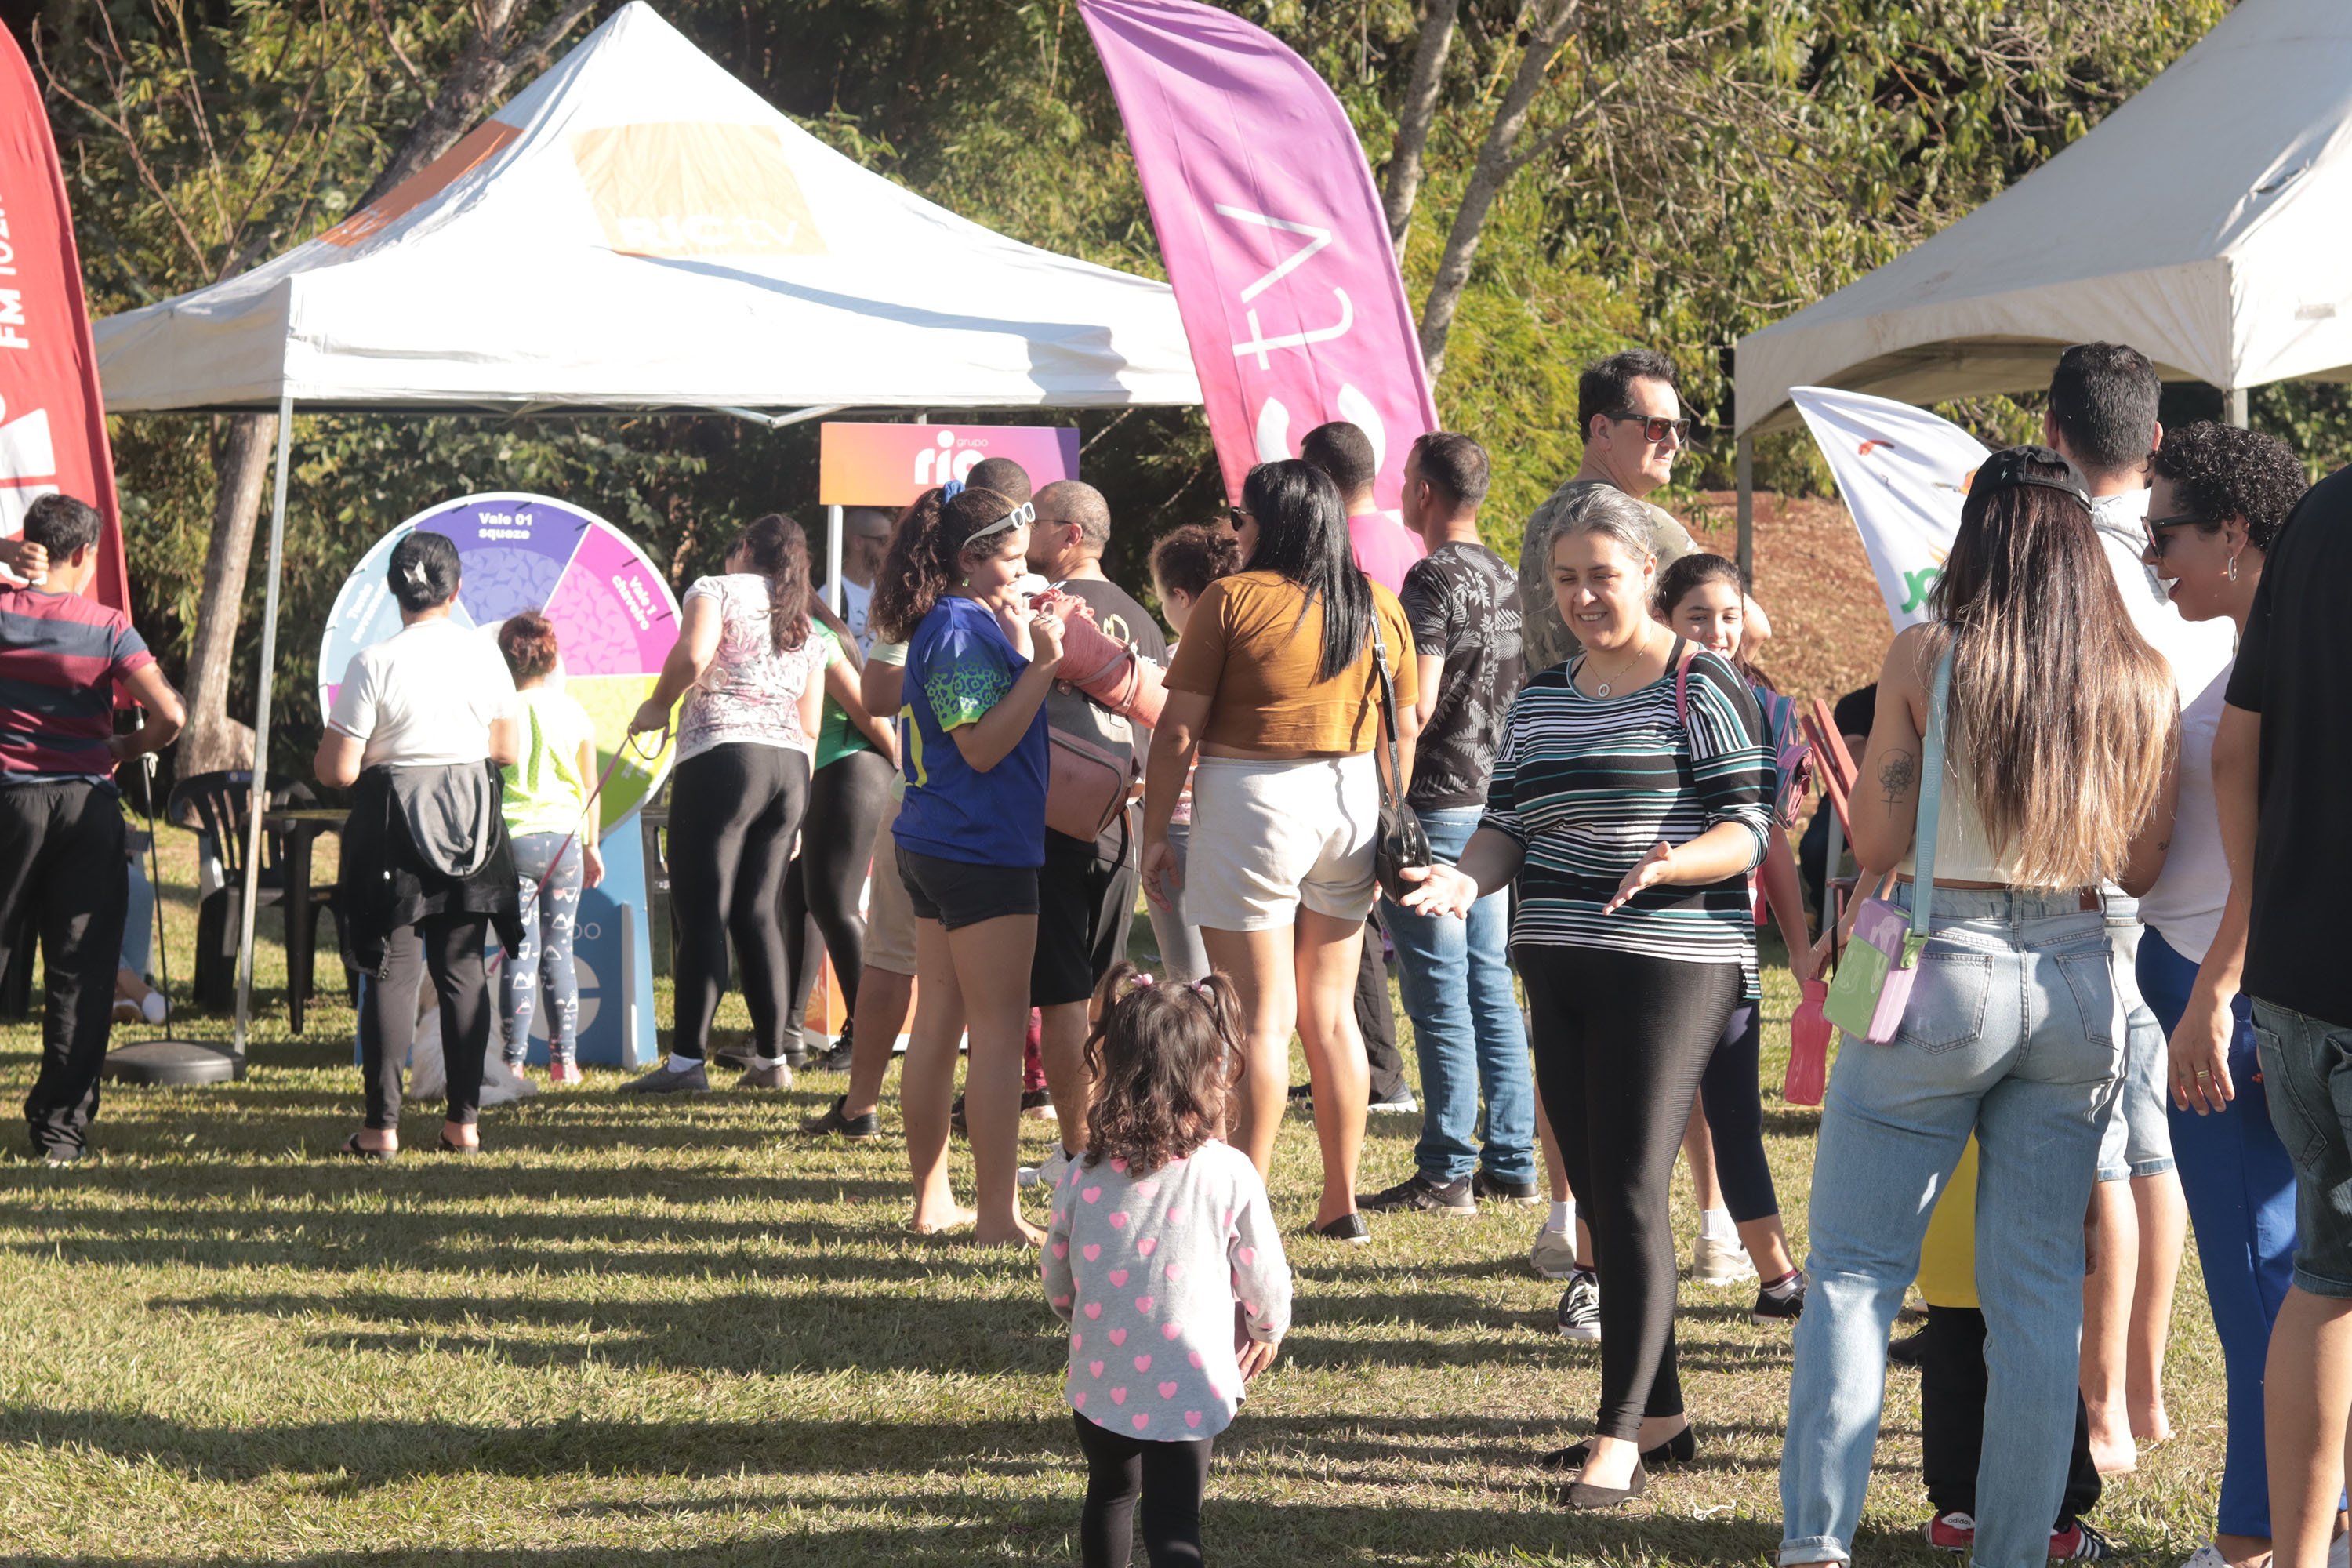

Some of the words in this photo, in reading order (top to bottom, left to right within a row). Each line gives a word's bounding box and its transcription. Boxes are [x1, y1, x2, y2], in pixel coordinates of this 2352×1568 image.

[956, 438, 989, 448] grupo
[478, 512, 512, 525] Vale
[515, 514, 532, 526] 01
[612, 575, 650, 631] chaveiro
[630, 575, 650, 606] Vale
[646, 604, 657, 615] 1
